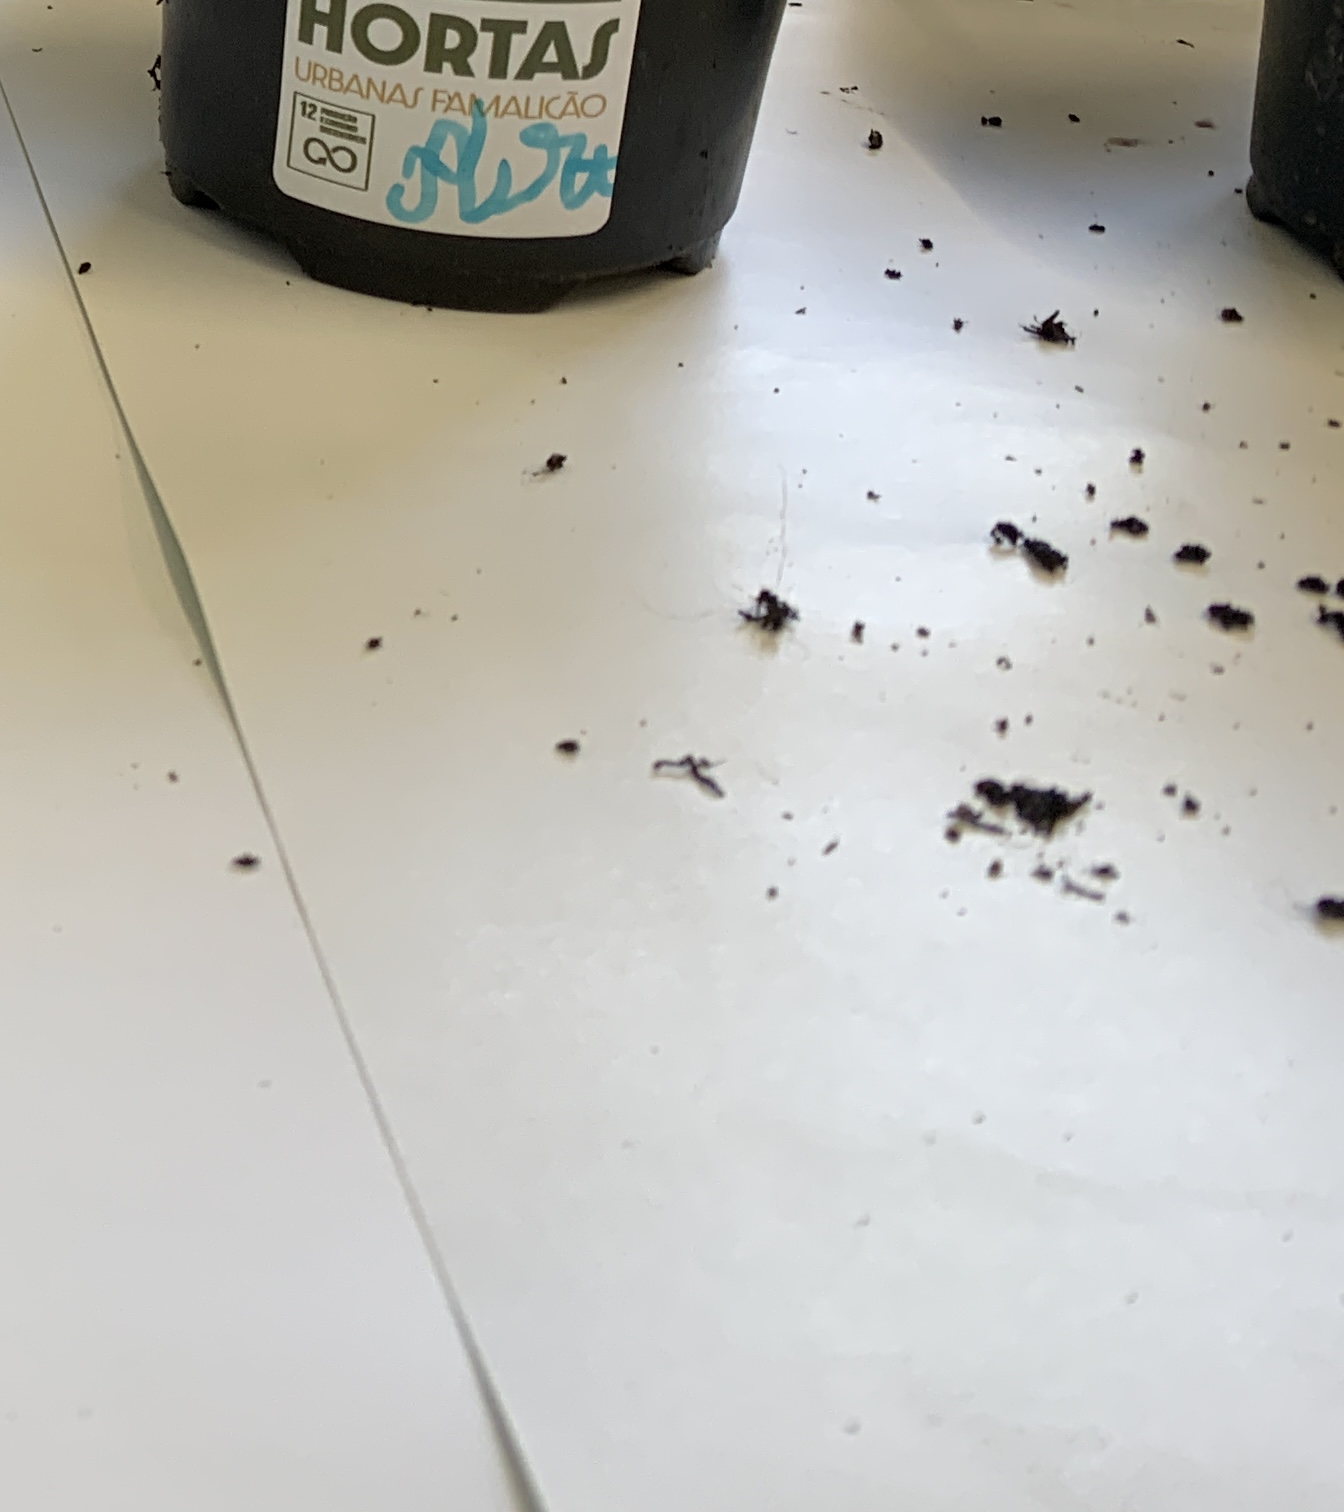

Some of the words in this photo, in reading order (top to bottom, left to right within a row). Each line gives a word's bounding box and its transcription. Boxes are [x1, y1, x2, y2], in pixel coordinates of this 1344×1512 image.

[294, 56, 424, 110] URBANAS
[431, 90, 607, 120] FAMALICÃO
[300, 100, 317, 121] 12
